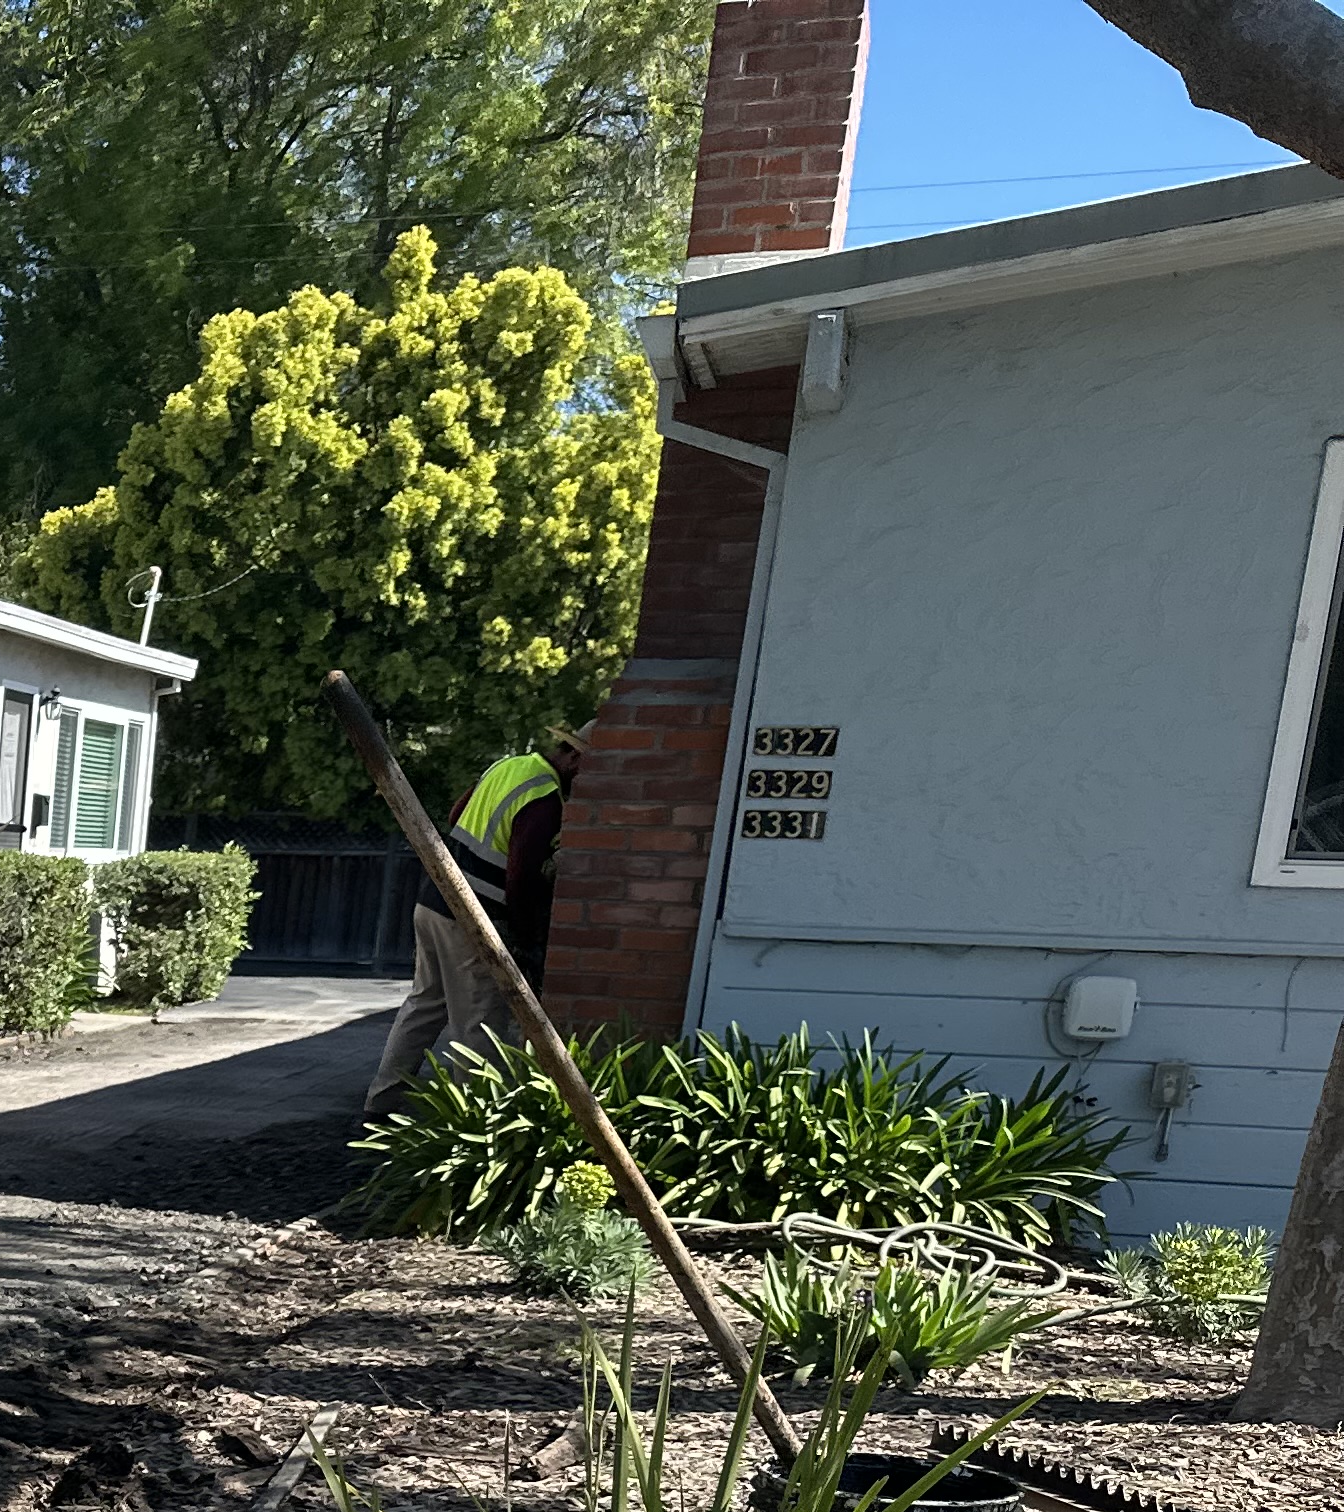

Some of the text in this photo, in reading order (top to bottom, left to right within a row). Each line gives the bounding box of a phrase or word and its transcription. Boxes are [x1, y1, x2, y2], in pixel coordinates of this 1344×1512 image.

[754, 728, 837, 756] 3327
[748, 771, 830, 798] 3329
[743, 811, 820, 839] 3331
